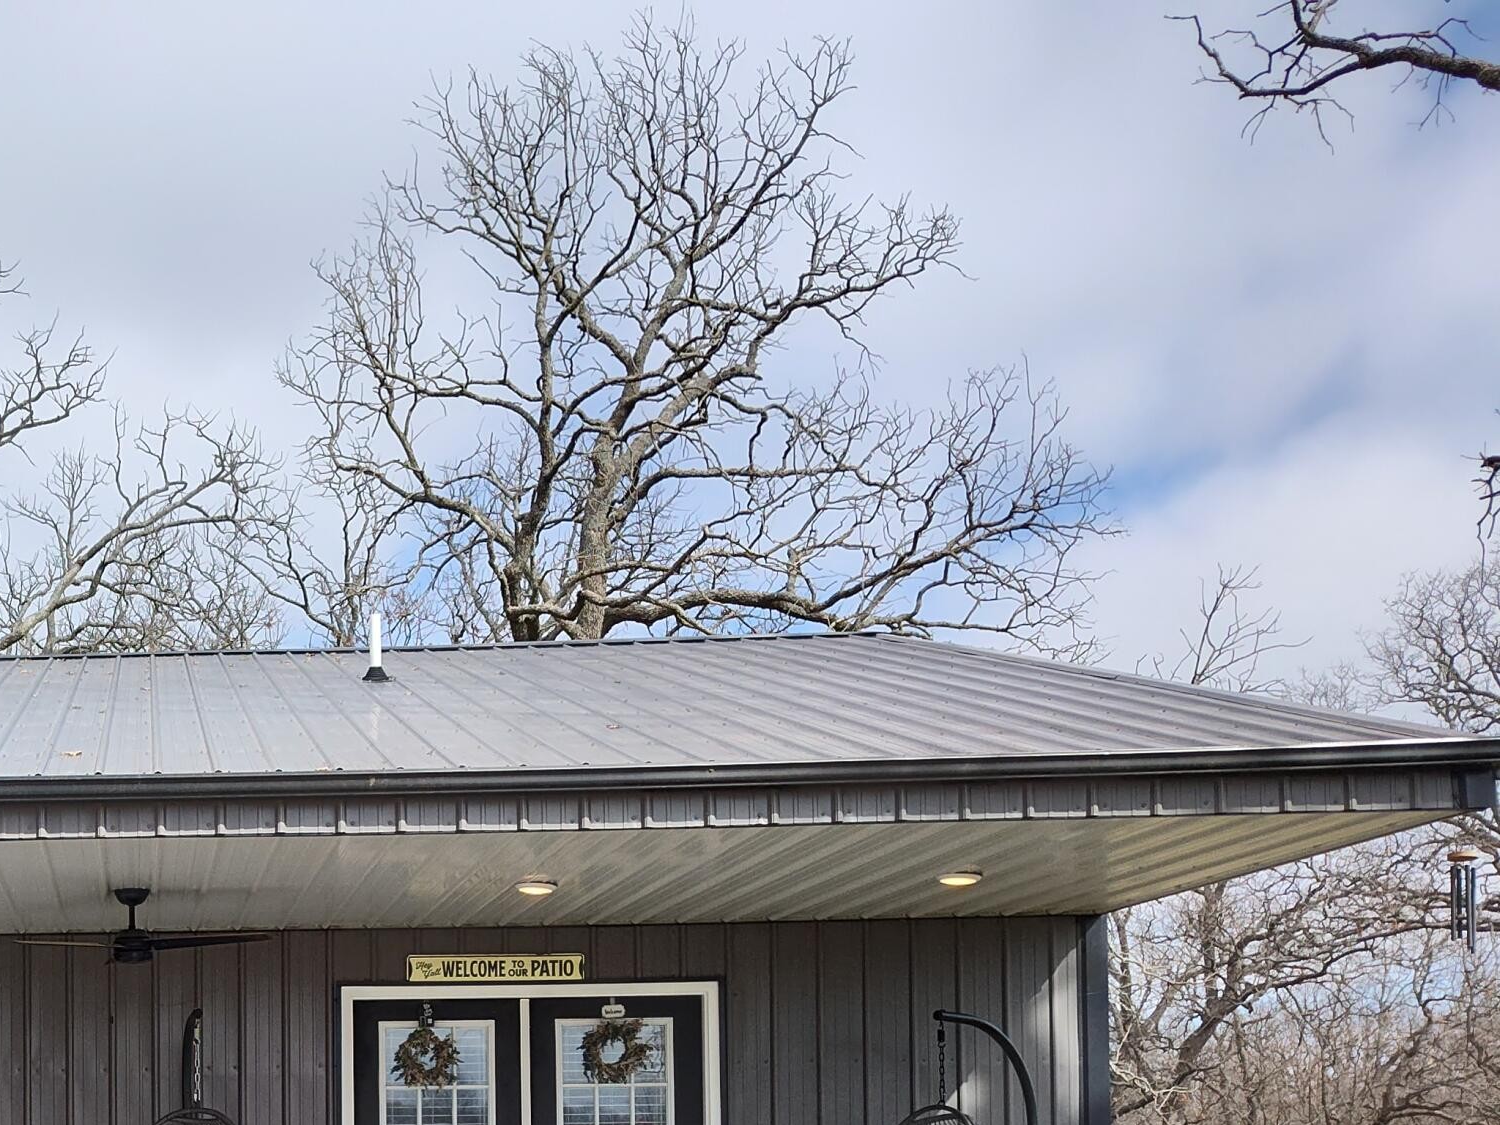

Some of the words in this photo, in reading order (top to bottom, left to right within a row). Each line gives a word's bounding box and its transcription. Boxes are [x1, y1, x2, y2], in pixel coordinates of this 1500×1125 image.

[441, 960, 506, 978] WELCOME
[511, 960, 525, 968] TO
[530, 959, 574, 977] PATIO
[508, 968, 528, 977] OUR
